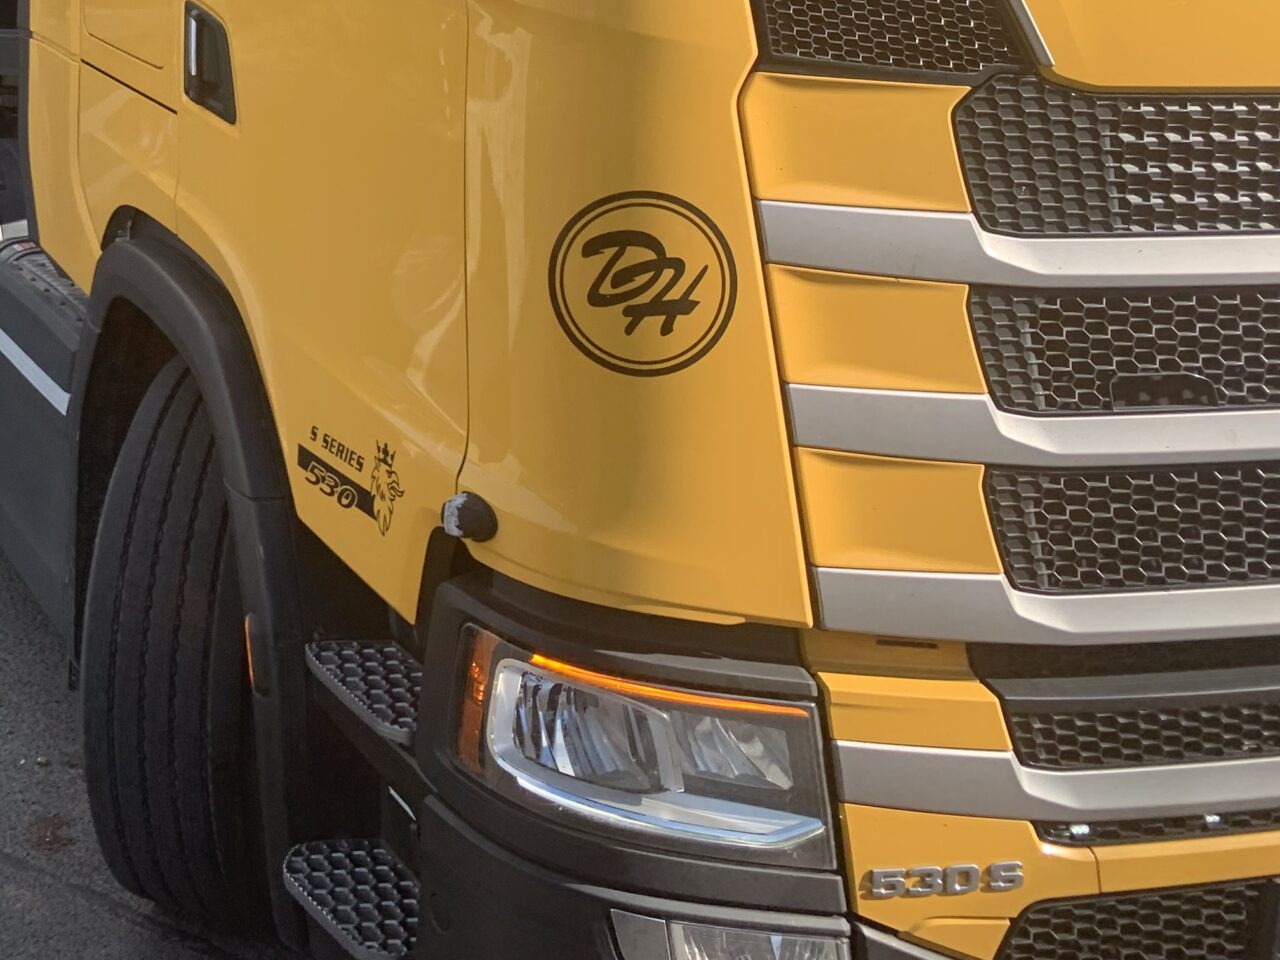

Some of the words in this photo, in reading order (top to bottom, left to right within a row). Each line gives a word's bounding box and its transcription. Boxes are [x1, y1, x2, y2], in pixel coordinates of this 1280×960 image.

[581, 229, 709, 337] DH
[310, 425, 319, 442] S
[321, 432, 365, 473] SERIES
[305, 461, 358, 509] 530
[870, 863, 980, 898] 530
[990, 860, 1024, 891] S
